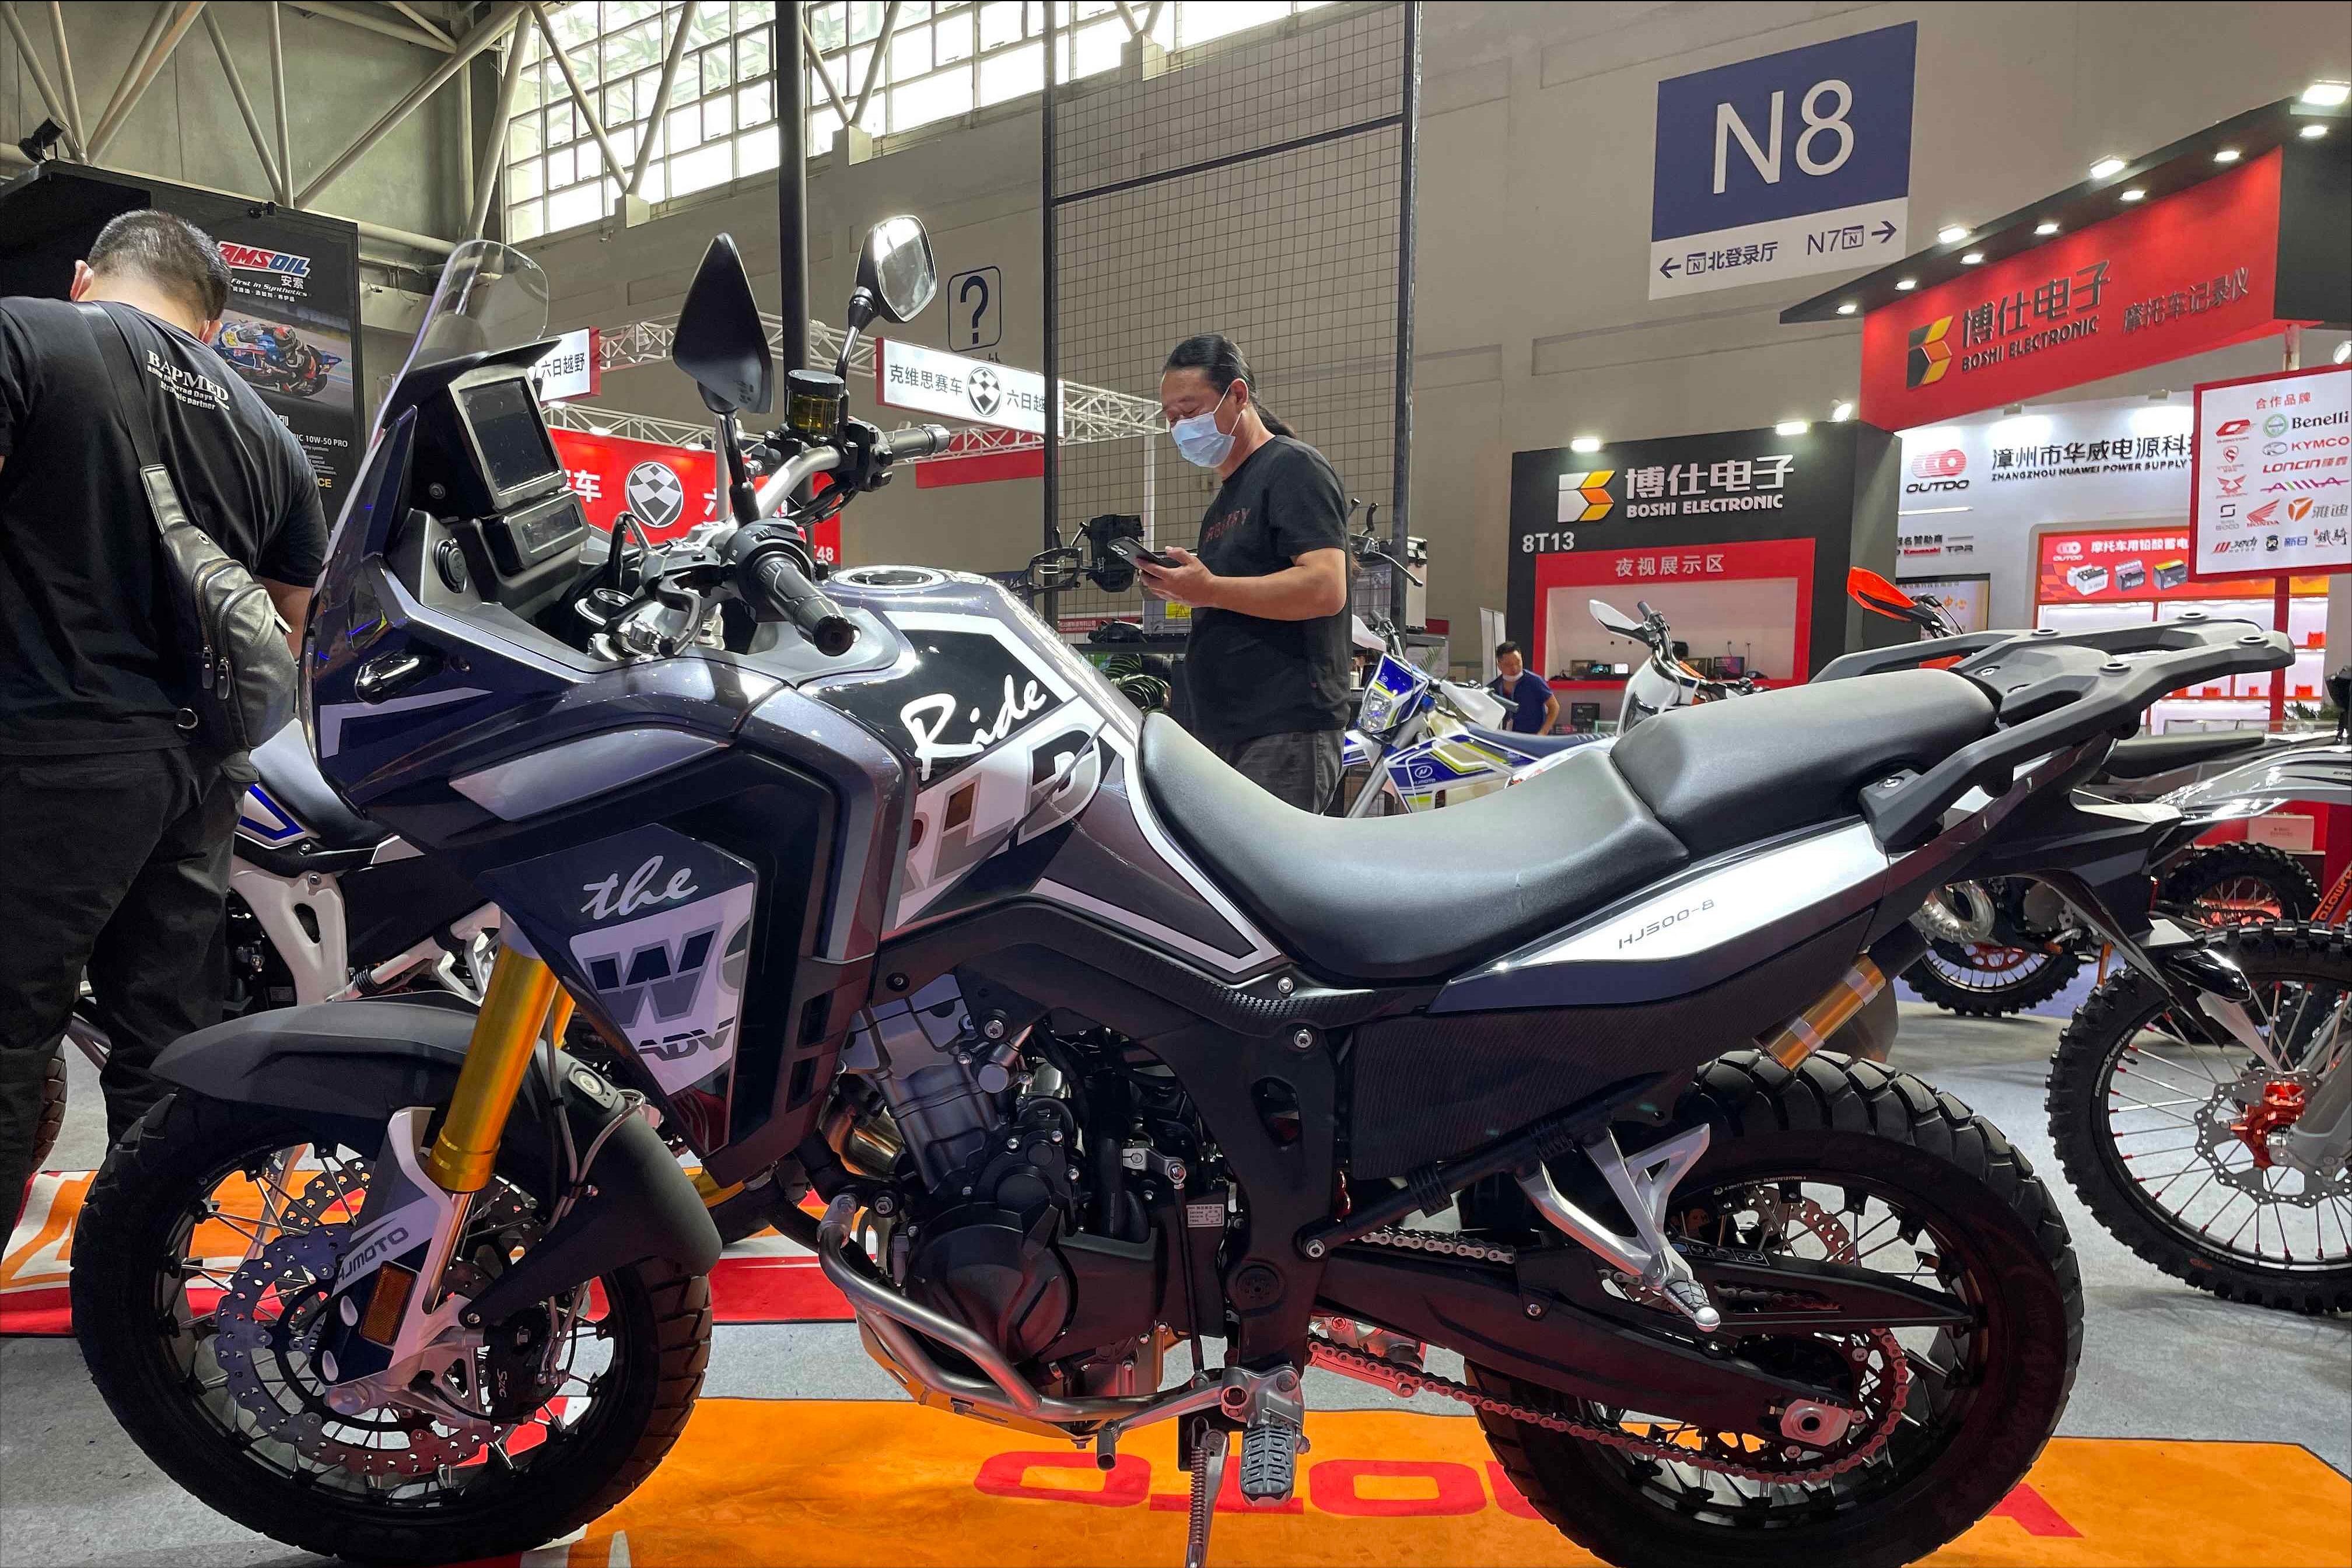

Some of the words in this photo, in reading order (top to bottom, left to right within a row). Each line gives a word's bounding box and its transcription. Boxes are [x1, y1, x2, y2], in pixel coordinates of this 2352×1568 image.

[1713, 79, 1854, 195] N8
[1708, 241, 1778, 271] 北登录厅
[1807, 230, 1841, 256] N7
[219, 243, 310, 276] AMSOIL
[262, 283, 308, 298] Synthetics
[1962, 259, 2111, 348] 博仕电子
[2123, 266, 2249, 335] 摩托车记录仪
[1961, 345, 2004, 372] BOSHI
[2008, 314, 2100, 359] ELECTRONIC
[146, 349, 229, 401] BAPMED
[541, 352, 585, 379] 六日越野
[890, 363, 963, 396] 克维思赛车
[2255, 391, 2311, 410] 合作品牌
[2291, 410, 2349, 429] Benelli
[305, 435, 332, 446] 10W-50
[333, 439, 348, 447] PRO
[1992, 433, 2193, 470] 漳州市华威电源科
[2291, 436, 2350, 451] KYMCO
[1625, 453, 1795, 500] 博仕电子
[1992, 470, 2056, 482] ZHANGZHOU
[2059, 466, 2100, 477] HUAWEI
[2104, 463, 2142, 473] POWER
[2144, 459, 2187, 470] SUPPLY
[1906, 479, 1970, 494] OUTDO
[1626, 501, 1676, 518] BOSHI
[1682, 493, 1783, 514] ELECTRONIC
[815, 545, 834, 562] 48
[1522, 531, 1575, 554] 8T13
[1945, 545, 1974, 554] TPR
[1615, 553, 1725, 578] 夜视展示区
[900, 674, 1048, 782] Ride
[580, 855, 699, 920] the
